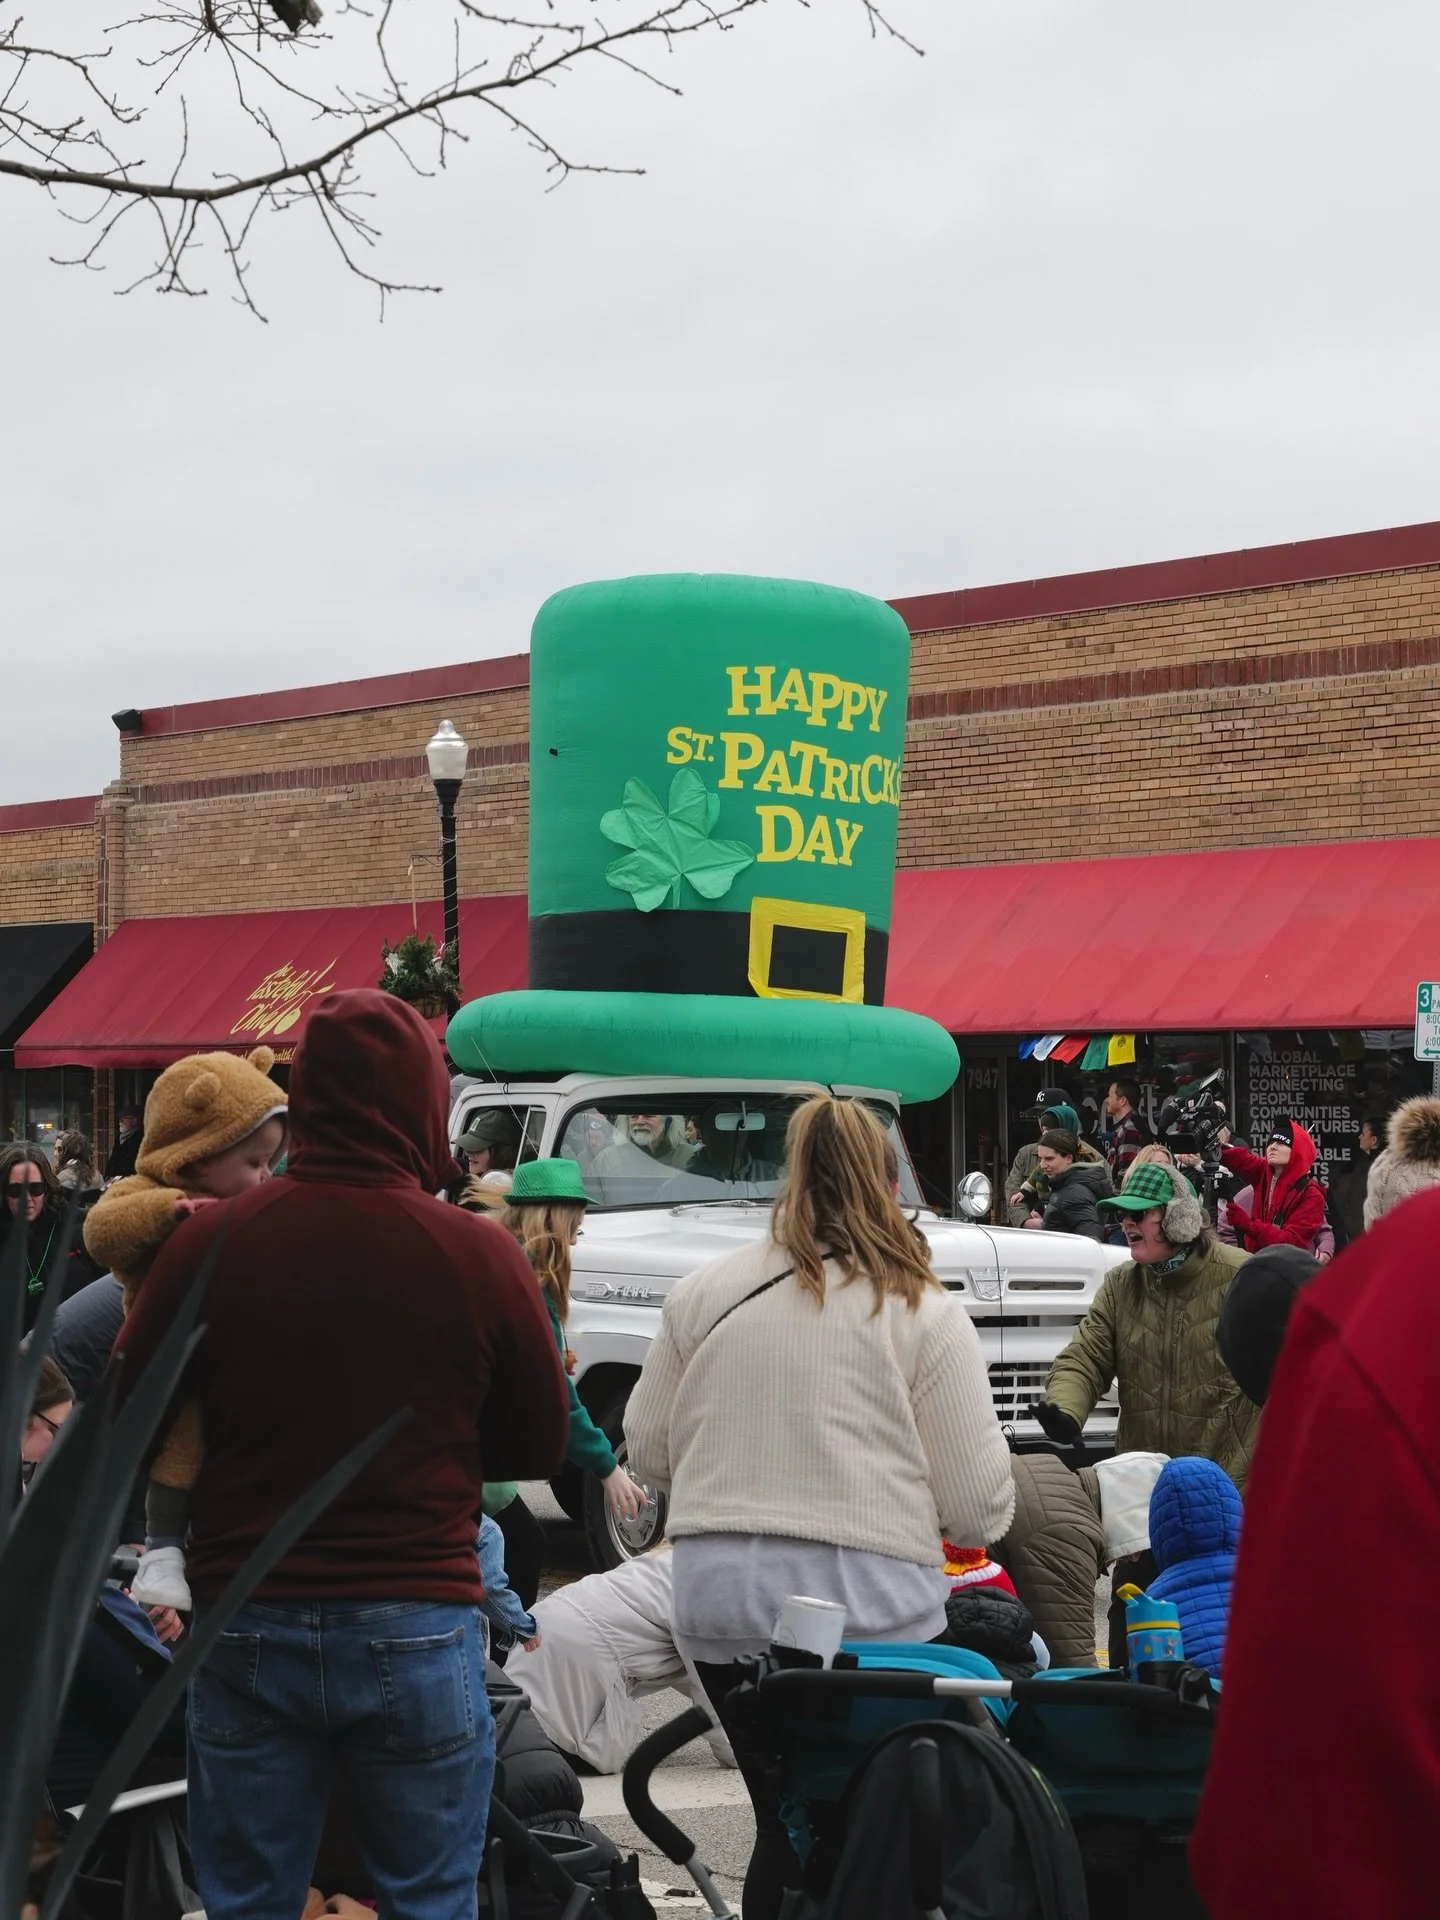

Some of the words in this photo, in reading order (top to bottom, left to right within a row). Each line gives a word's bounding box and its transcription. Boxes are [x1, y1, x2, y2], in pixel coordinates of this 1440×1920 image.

[726, 665, 888, 733] HAPPY
[666, 726, 714, 765] ST.
[755, 805, 864, 867] DAY
[1420, 988, 1430, 1008] 3
[273, 1047, 296, 1061] ealth!
[1249, 1051, 1259, 1063] A
[1263, 1051, 1321, 1064] GLOBAL
[1249, 1064, 1356, 1077] MARKETPLACE
[966, 1068, 999, 1089] 7947
[1249, 1078, 1345, 1091] CONNECTING
[1250, 1092, 1305, 1105] PEOPLE
[1250, 1106, 1351, 1119] COMMUNITIES
[1250, 1120, 1275, 1133] AN
[614, 1285, 650, 1299] FORD
